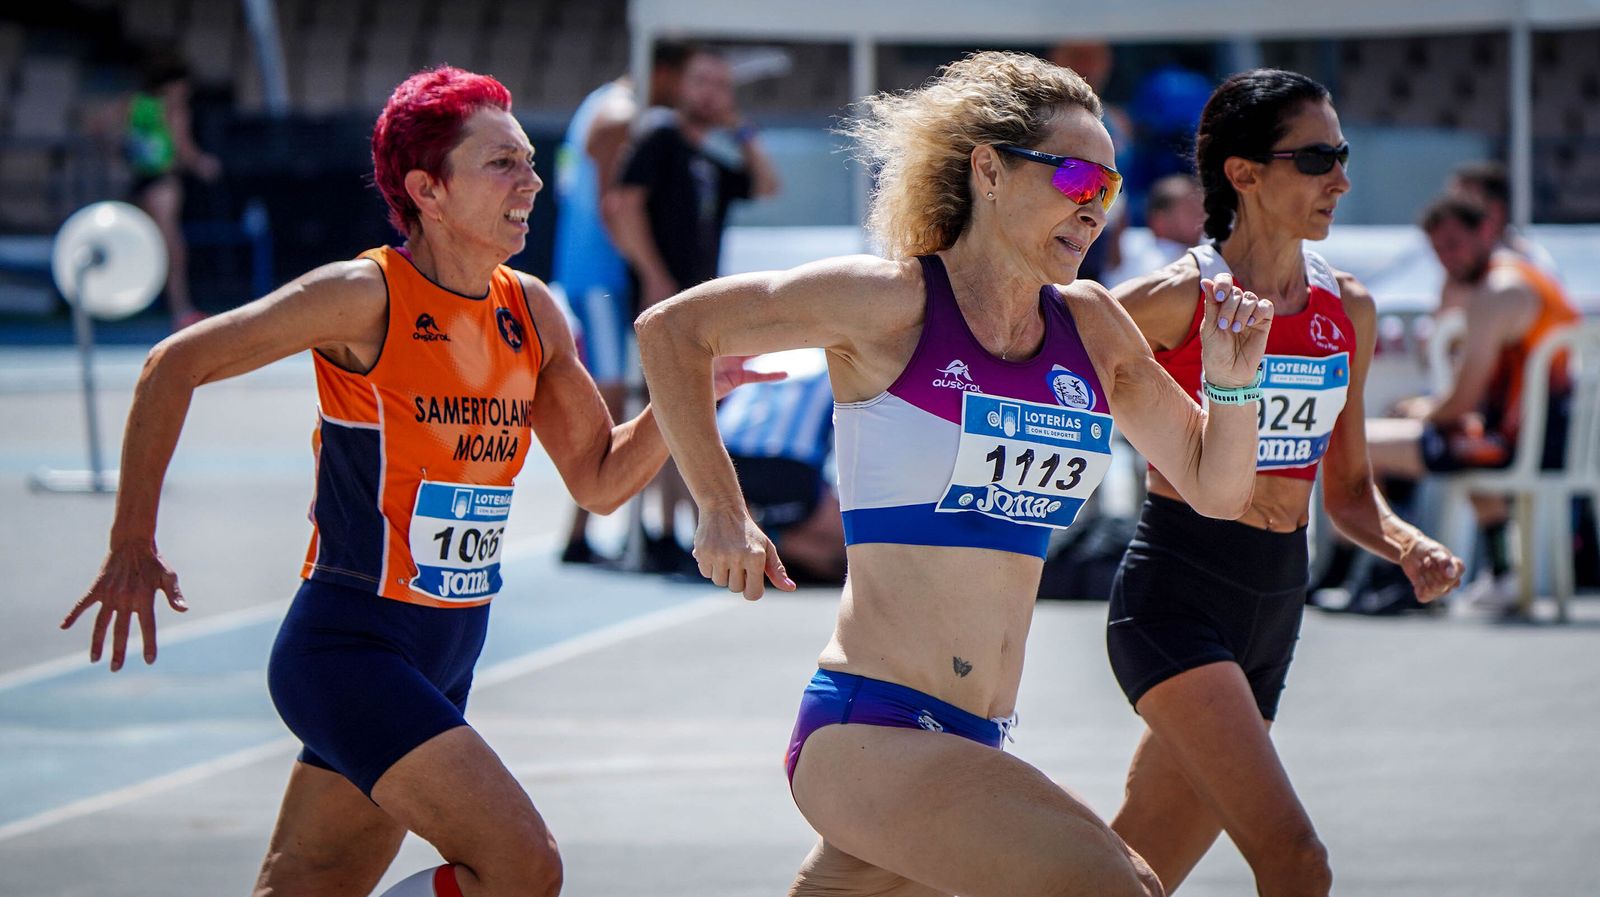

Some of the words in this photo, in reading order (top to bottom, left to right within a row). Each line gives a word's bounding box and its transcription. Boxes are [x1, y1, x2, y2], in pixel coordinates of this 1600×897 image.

[1270, 362, 1326, 374] LOTERÍAS
[1025, 411, 1082, 429] LOTERÍAS
[453, 429, 518, 462] MOAÑA
[1051, 430, 1074, 439] DEPORTE
[1257, 438, 1312, 461] oma
[986, 444, 1087, 491] 1113
[977, 485, 1047, 518] Joma
[433, 526, 505, 563] 1066
[438, 570, 489, 596] Joma
